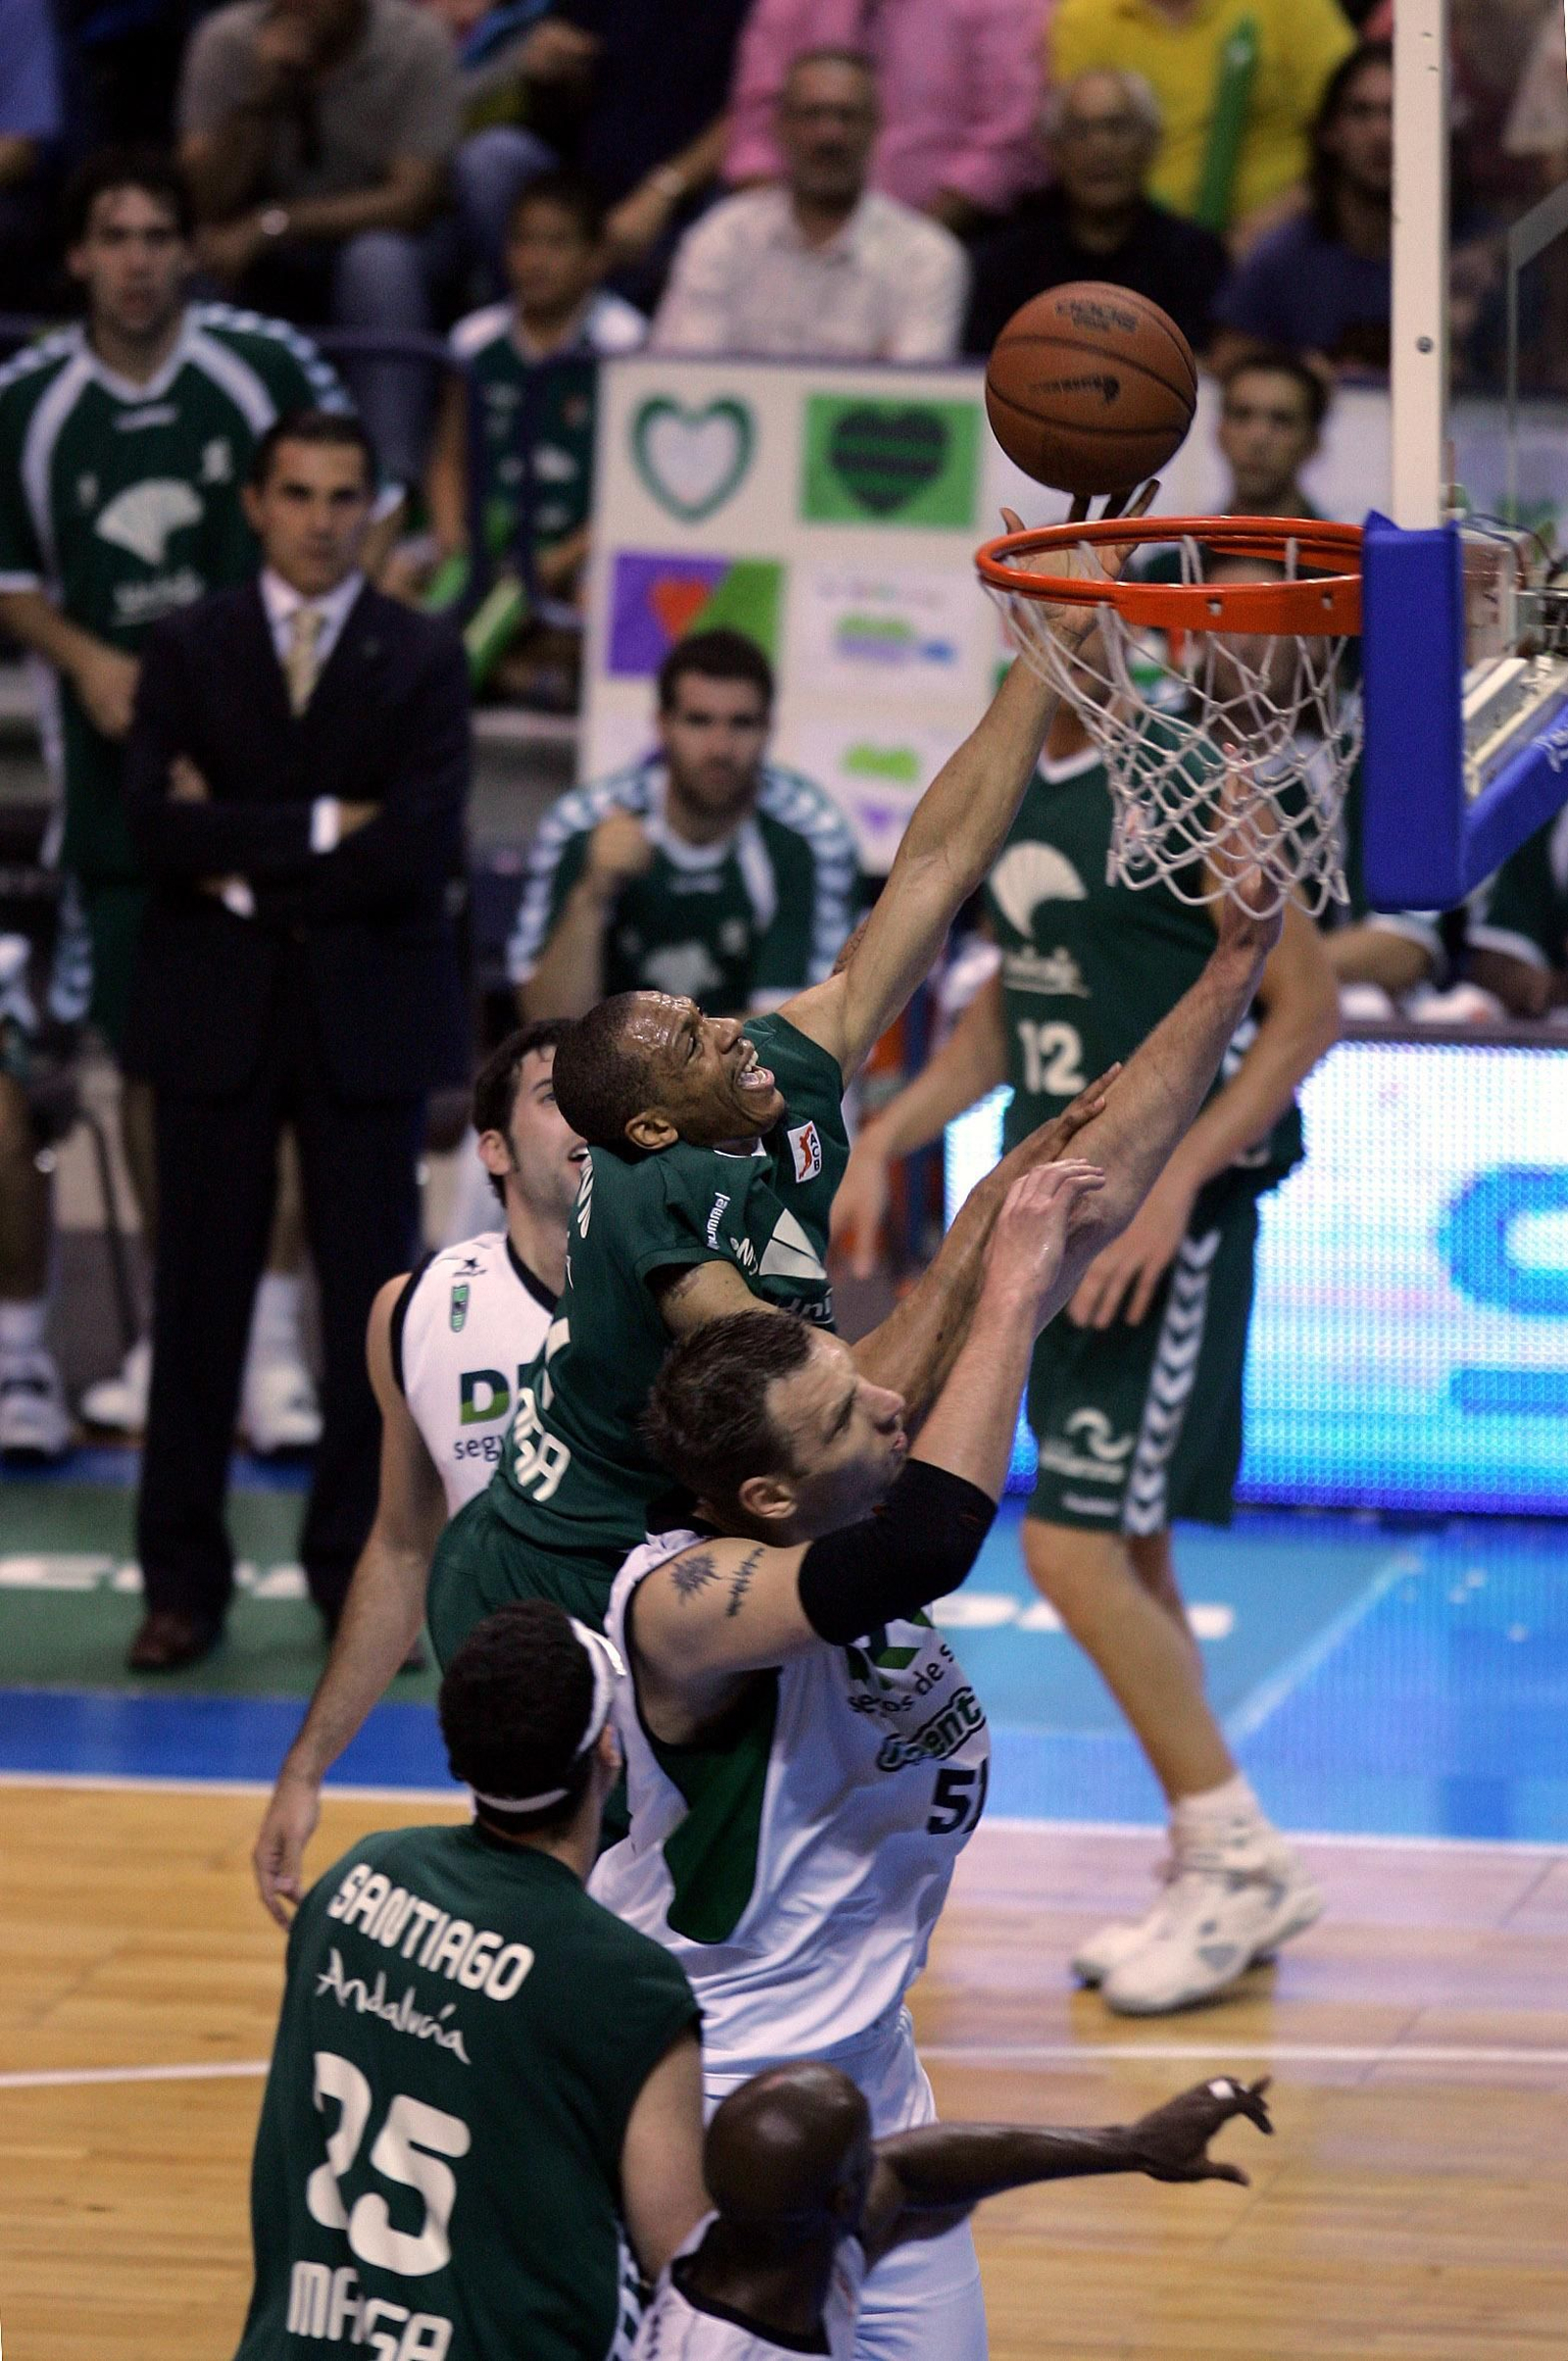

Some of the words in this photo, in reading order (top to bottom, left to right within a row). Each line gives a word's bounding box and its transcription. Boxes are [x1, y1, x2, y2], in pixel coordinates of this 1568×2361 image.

[1018, 1019, 1086, 1096] 12
[810, 1133, 821, 1172] ACB
[912, 1662, 945, 1696] de
[326, 1862, 535, 2001] SANTIAGO
[306, 2050, 471, 2277] 25
